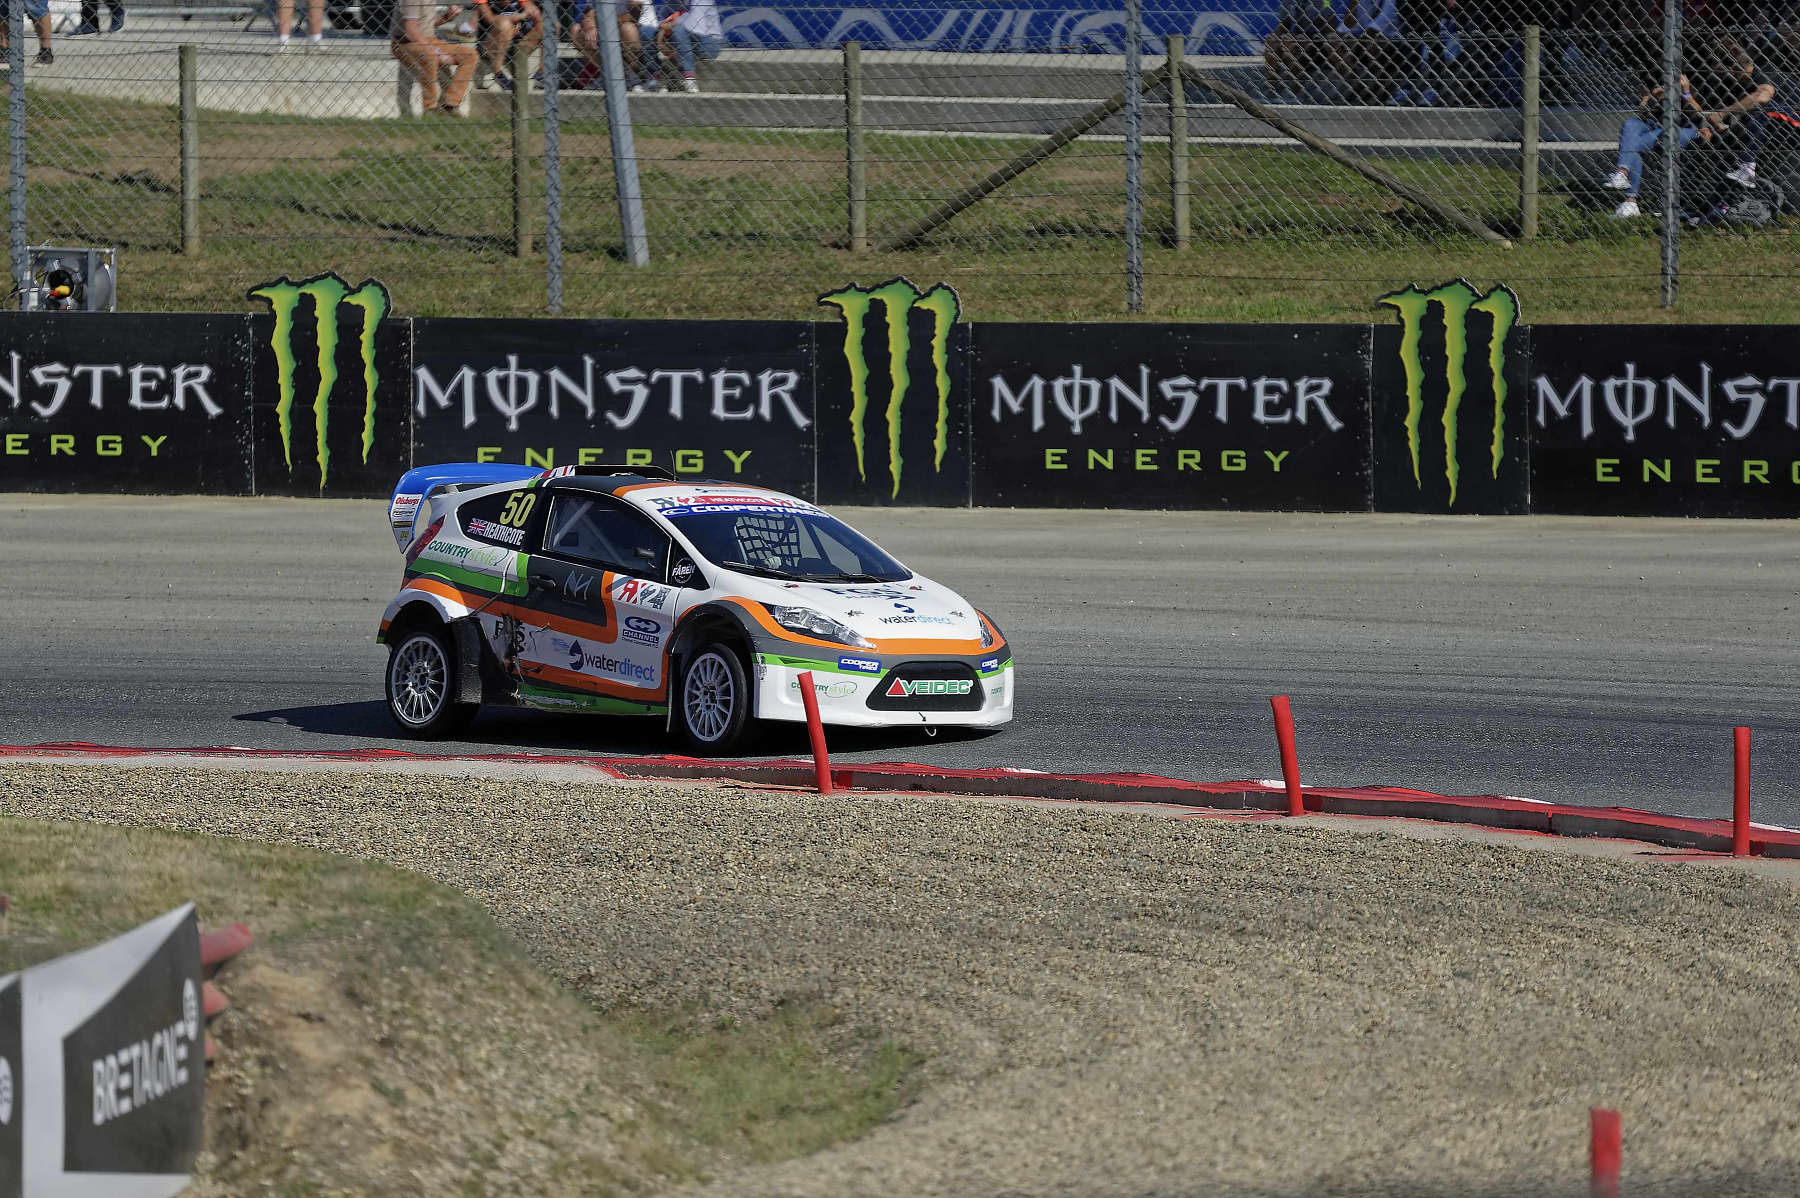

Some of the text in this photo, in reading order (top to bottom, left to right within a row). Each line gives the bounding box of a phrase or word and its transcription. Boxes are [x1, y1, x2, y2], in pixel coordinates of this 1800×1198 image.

[415, 353, 812, 431] MONSTER
[989, 363, 1344, 435] MONSTER
[5, 433, 168, 457] ERGY
[477, 446, 753, 473] ENERGY
[1044, 448, 1290, 473] ENERGY
[499, 491, 537, 528] 50
[483, 521, 526, 546] HEATHCOTE
[623, 630, 659, 643] CHANNEL
[840, 659, 880, 668] COOPER
[93, 1020, 189, 1126] BRETAGNE
